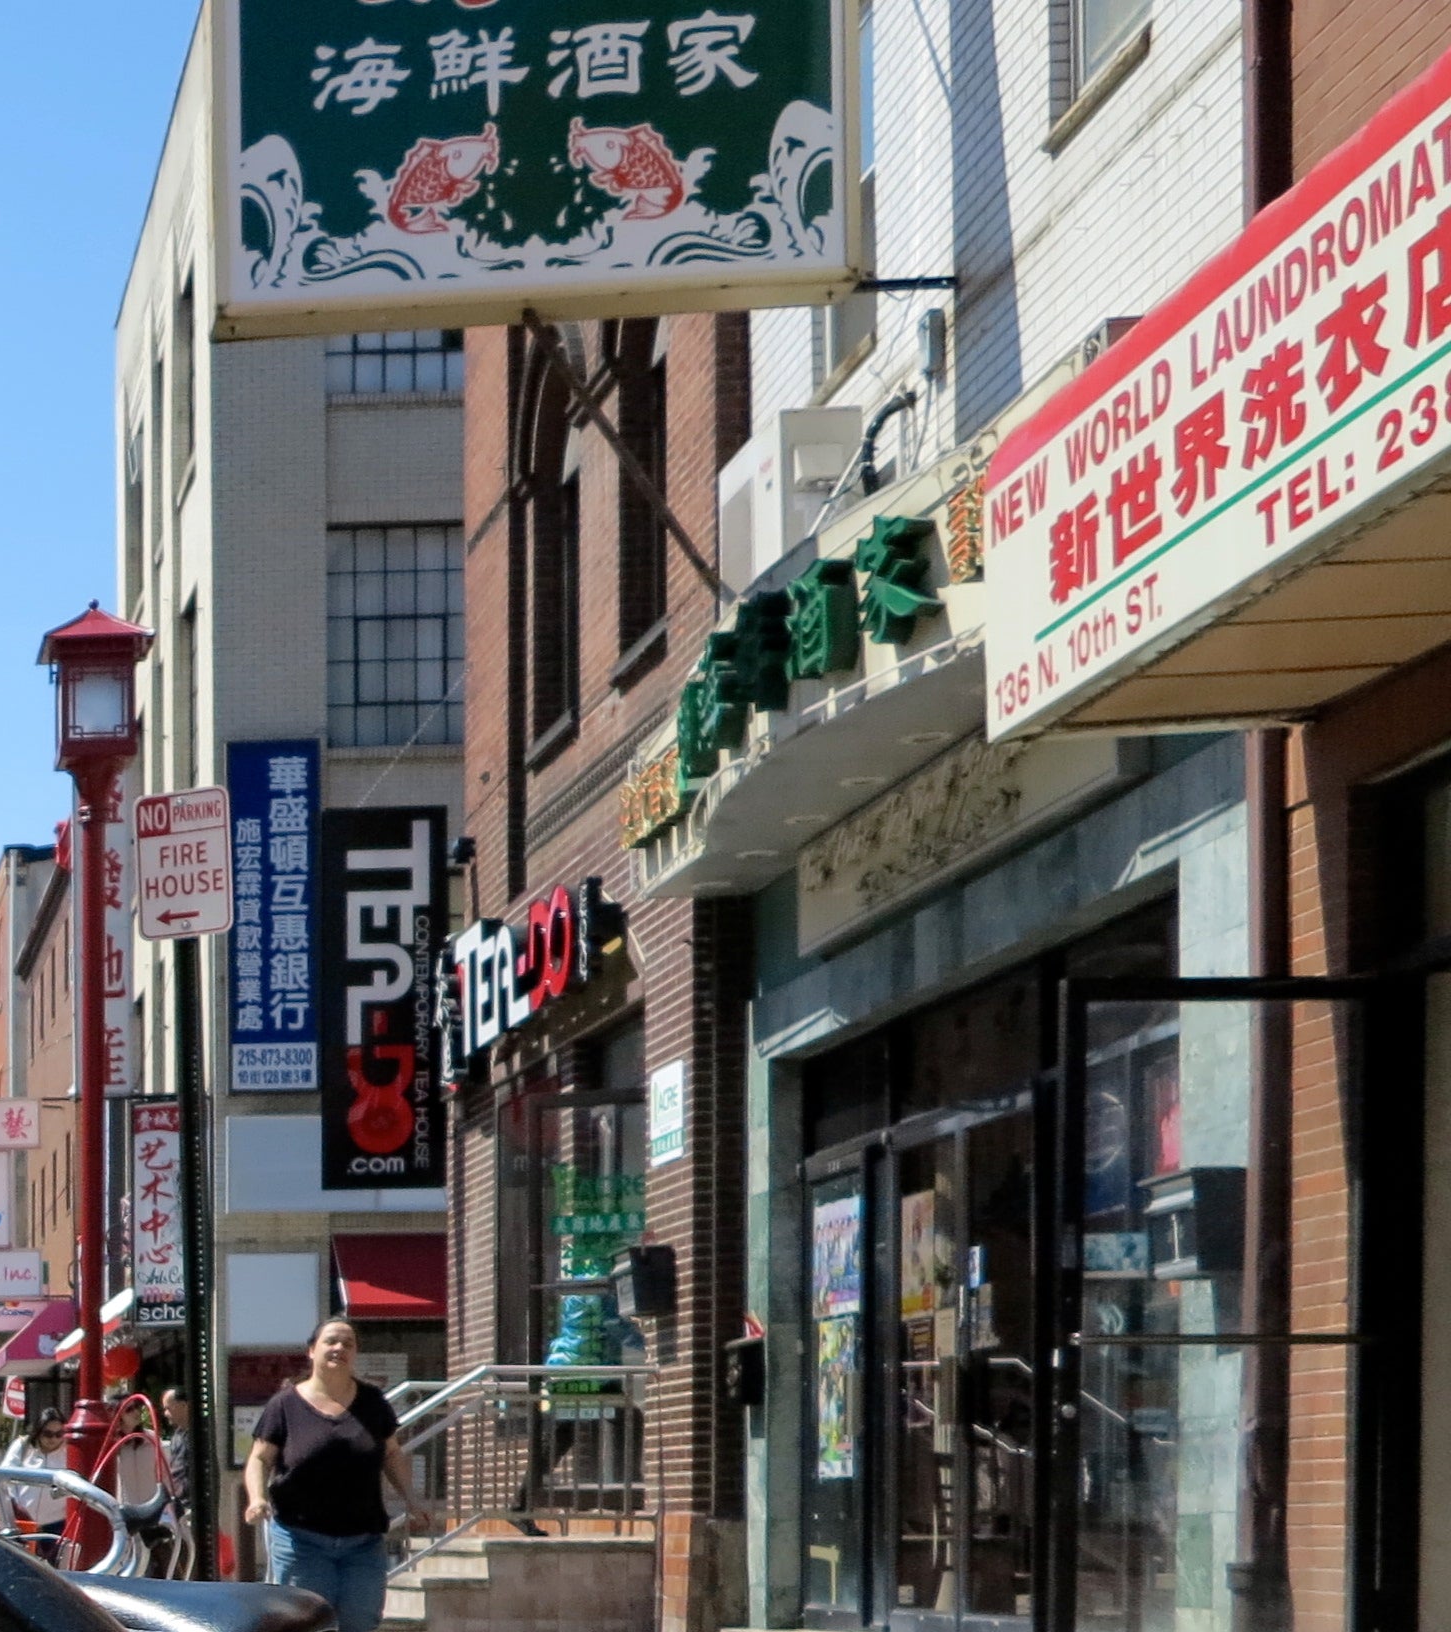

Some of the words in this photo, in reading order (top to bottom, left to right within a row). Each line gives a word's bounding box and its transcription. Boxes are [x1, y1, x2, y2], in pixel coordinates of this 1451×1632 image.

[311, 10, 760, 116] 海鮮酒家
[989, 452, 1049, 547] NEW
[1066, 357, 1172, 473] WORLD
[1256, 452, 1356, 547] TEL:
[1375, 370, 1451, 472] 23
[994, 661, 1030, 720] 136
[1036, 641, 1061, 695] N.
[1066, 600, 1118, 669] 10th
[1125, 571, 1163, 630] ST.
[139, 803, 168, 833] NO
[173, 799, 222, 824] PARKING
[145, 868, 225, 901] HOUSE
[159, 841, 208, 869] FIRE
[267, 755, 310, 1032] 華盛頓互惠銀行
[414, 914, 431, 1061] CONTEMPORARY
[237, 1048, 313, 1067] 215-873-8300
[414, 1071, 430, 1102] TEA
[414, 1107, 430, 1168] HOUSE
[3, 1266, 37, 1282] Inc.
